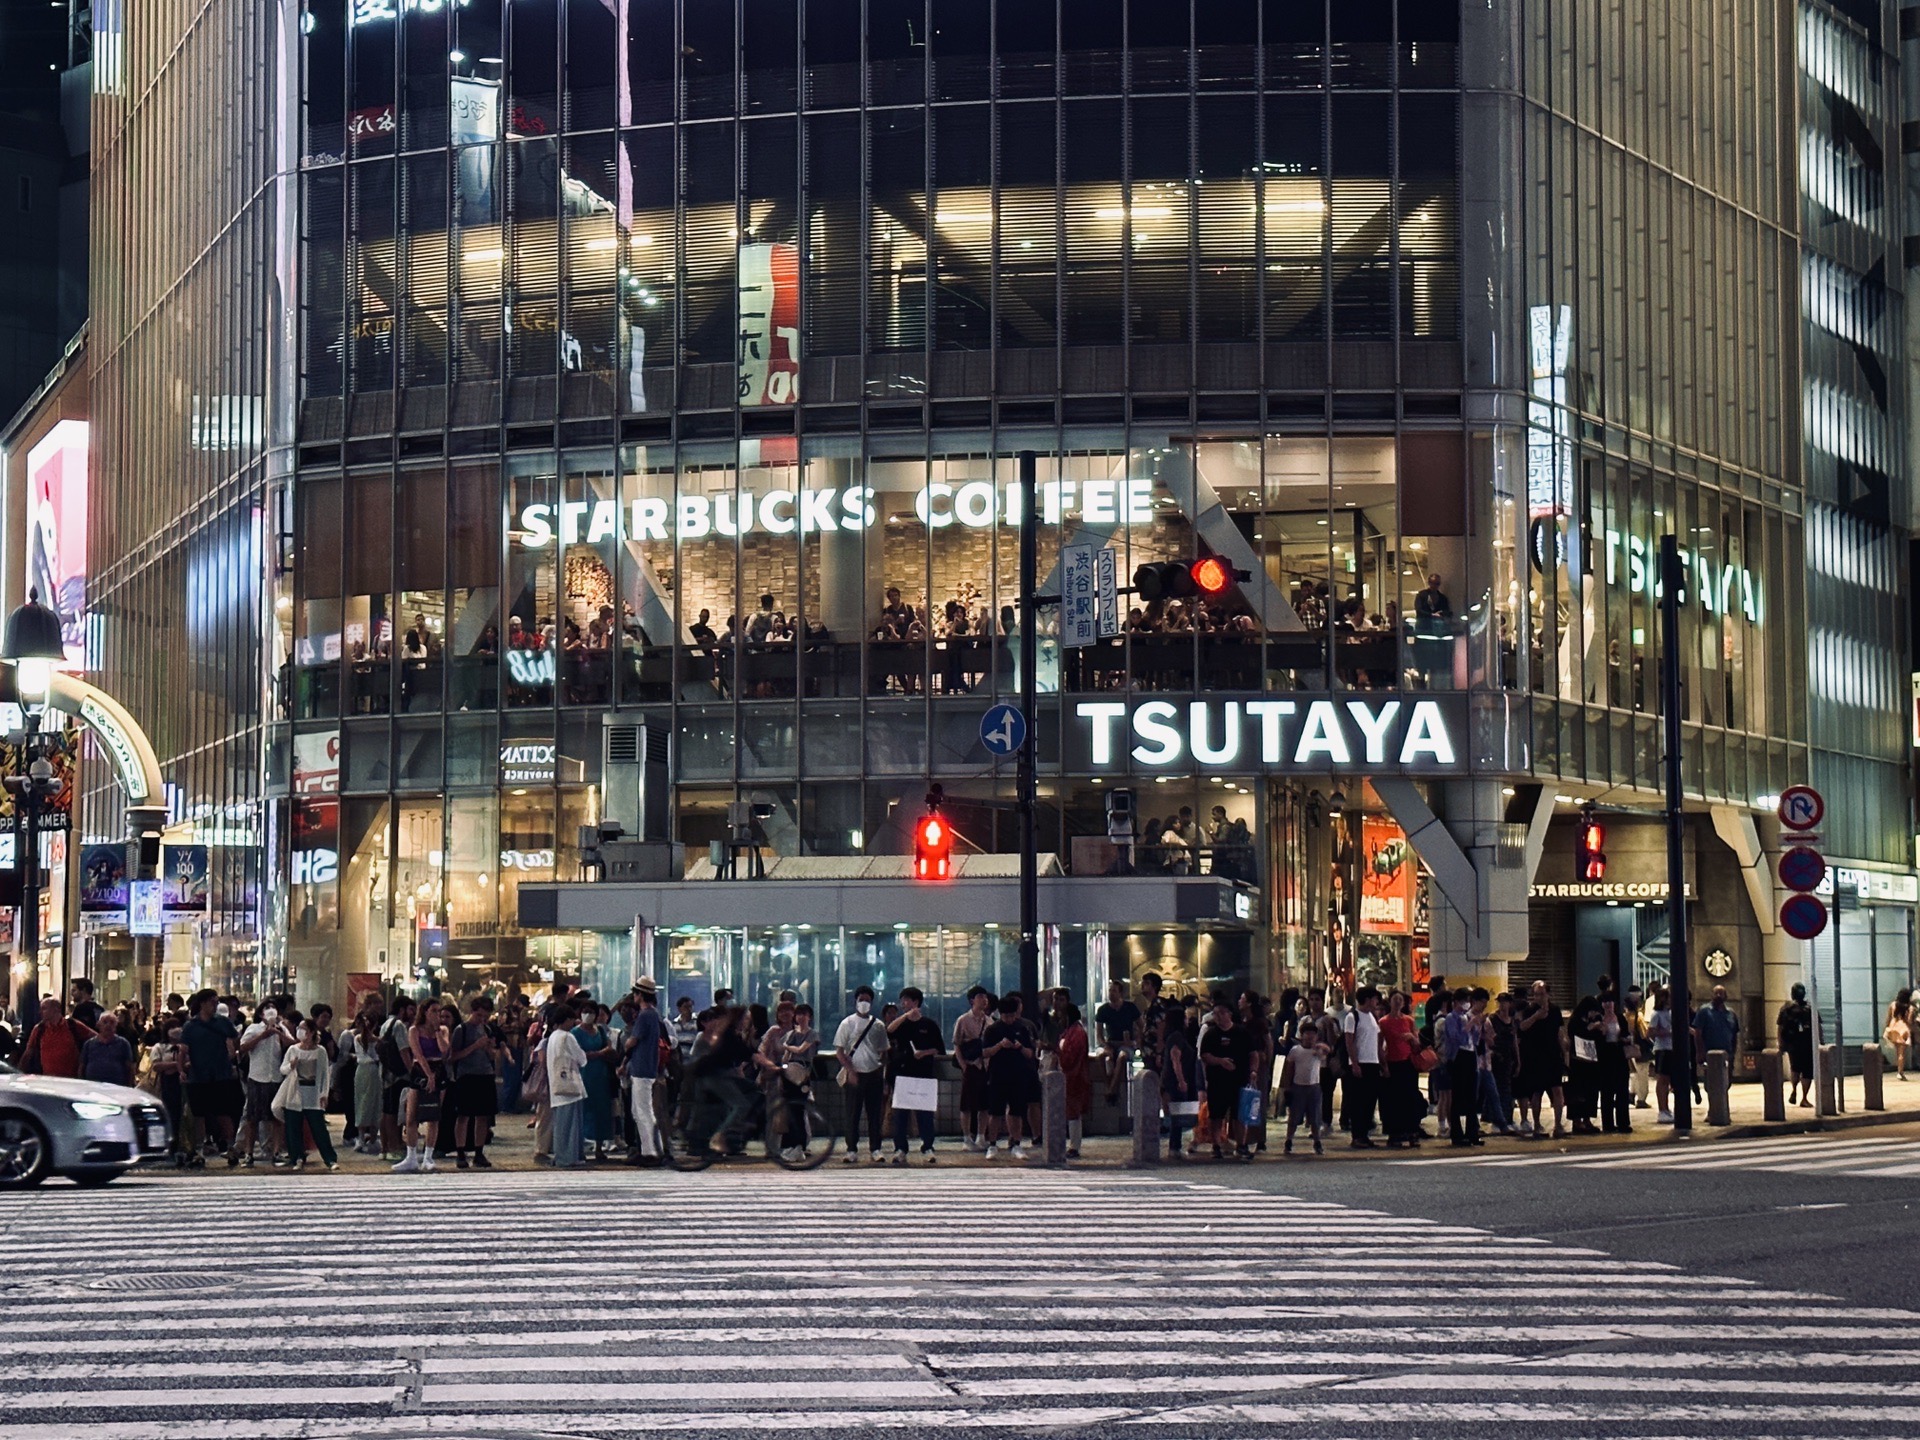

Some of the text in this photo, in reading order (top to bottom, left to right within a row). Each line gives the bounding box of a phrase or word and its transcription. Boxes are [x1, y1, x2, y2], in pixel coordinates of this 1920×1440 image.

[520, 479, 1153, 548] STARBUCKS COFFEE
[1066, 566, 1075, 605] Shibuya
[1075, 551, 1091, 638] 渋谷駅前
[1101, 551, 1115, 633] スクランブル式
[1076, 700, 1455, 765] TSUTAYA
[21, 812, 67, 829] SMMER
[176, 863, 194, 874] 100
[1528, 883, 1691, 897] STARBUCKS COFFE
